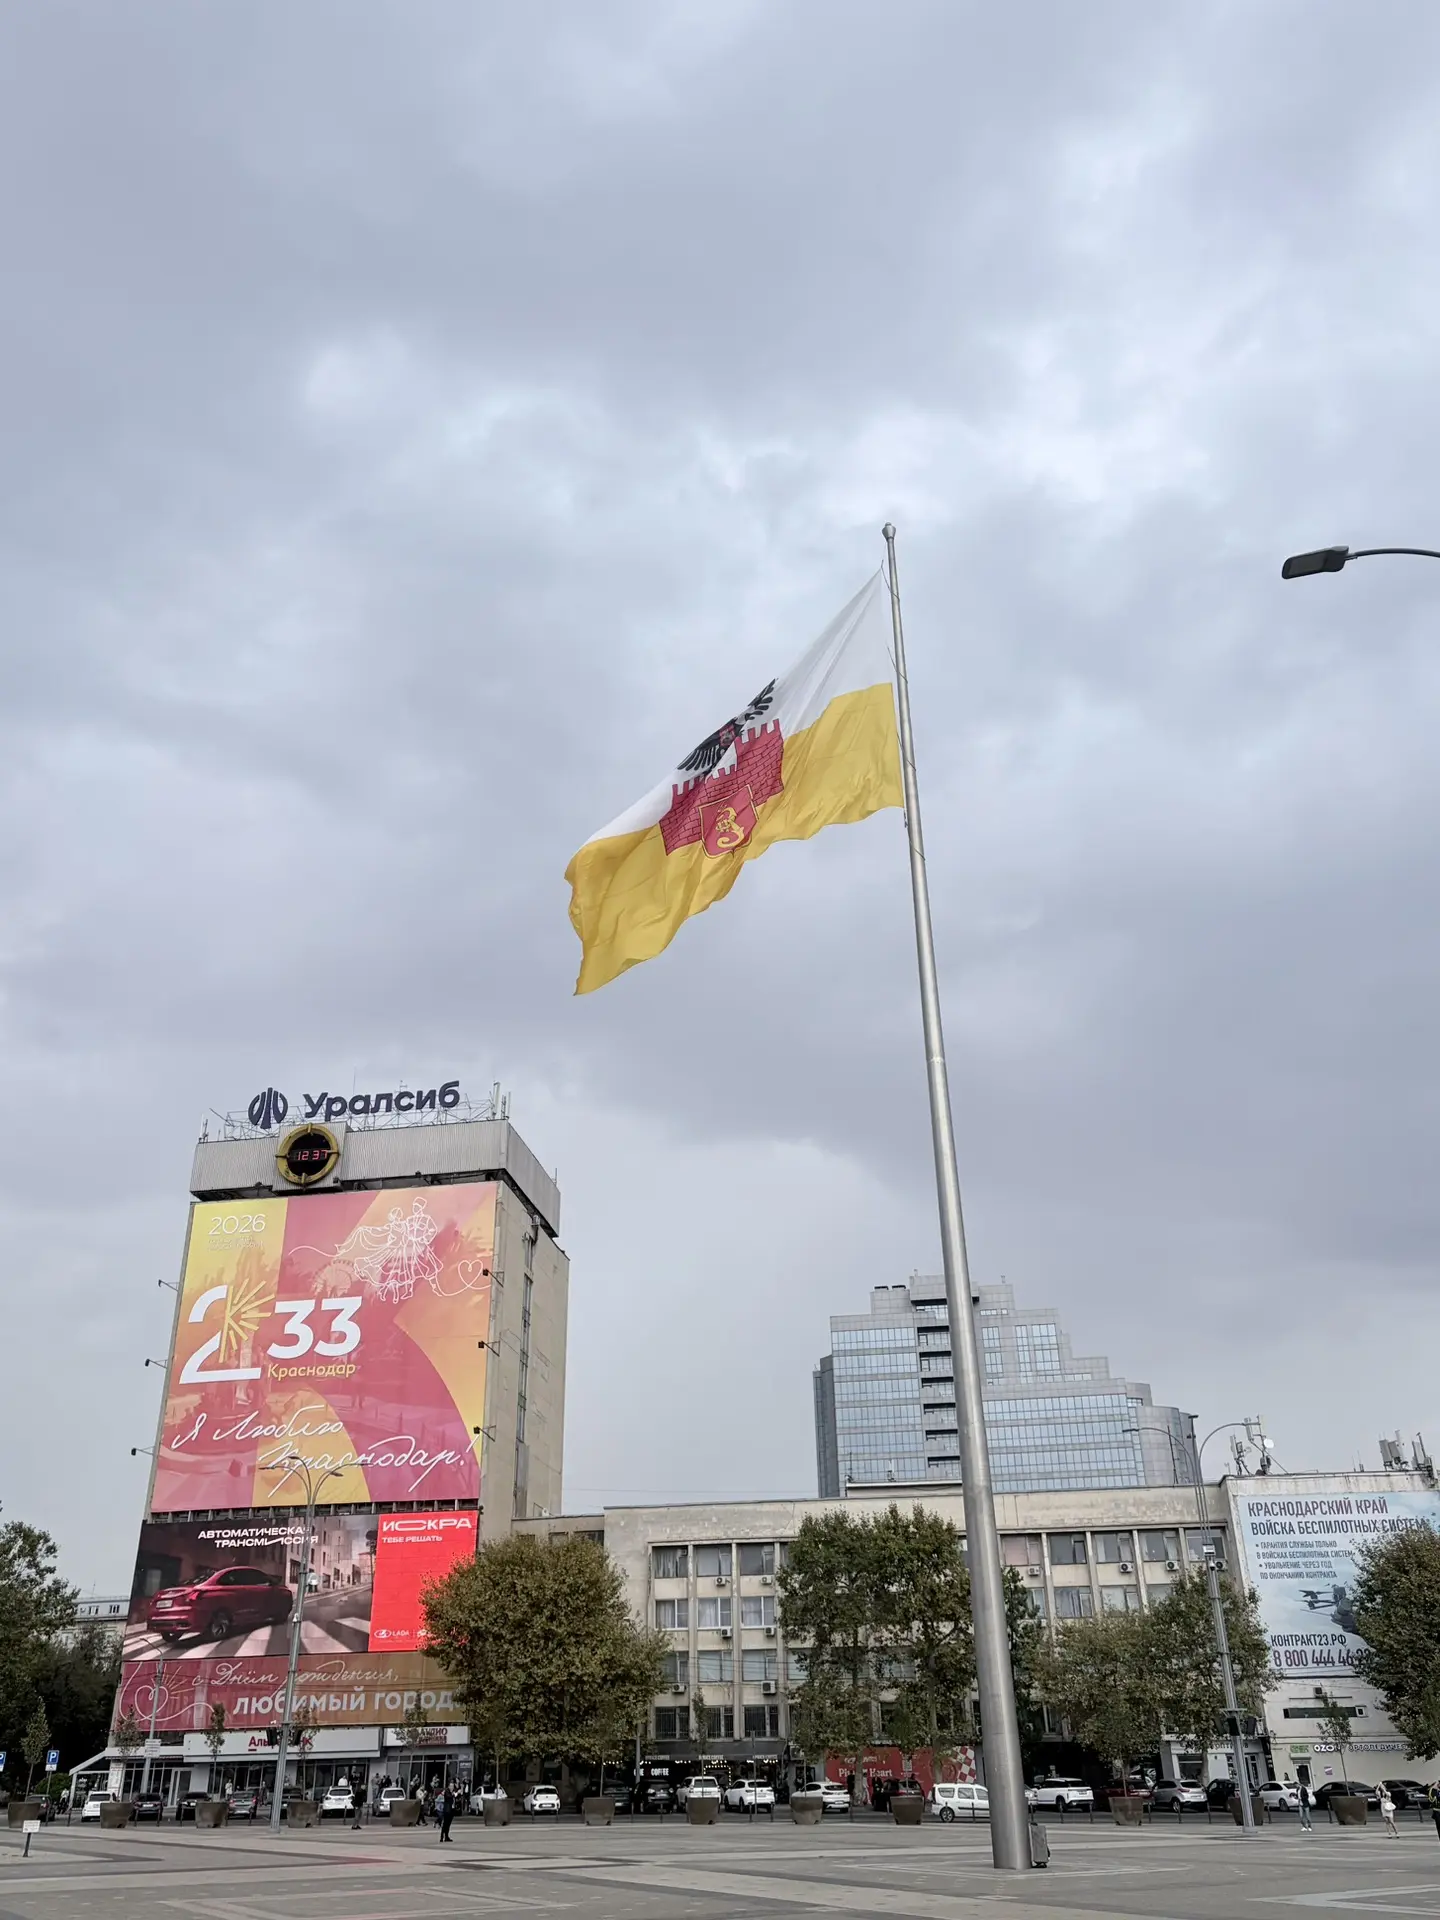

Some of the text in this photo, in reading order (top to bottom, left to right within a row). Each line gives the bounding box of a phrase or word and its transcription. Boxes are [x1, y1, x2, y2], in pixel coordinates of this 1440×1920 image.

[302, 1080, 460, 1122] Уралсиб
[208, 1213, 266, 1235] 2026
[267, 1362, 356, 1380] Краснодар
[170, 1412, 207, 1449] Я
[1247, 1496, 1388, 1518] КРАСНОДАРСКИЙ КРАЙ
[382, 1518, 472, 1532] ИСКРА
[1250, 1519, 1296, 1536] ВОЙСКА
[1299, 1519, 1379, 1535] БЕСПИЛОТНЫХ
[1260, 1541, 1288, 1549] ГАРАНТИЯ
[1314, 1540, 1337, 1548] ТОЛЬКО
[1262, 1550, 1288, 1559] ВОЙСКАХ
[1288, 1550, 1330, 1558] БЕСПИЛОТНЫХ
[1264, 1560, 1333, 1569] УВОЛЬНЕНИЕ ЧЕРЕЗ ГОД
[1260, 1571, 1338, 1580] ПО ОКОНЧАНИЮ КОНТРАКТА
[1271, 1633, 1346, 1647] КОНТРАКТ23.РФ
[1273, 1650, 1282, 1667] 8
[1284, 1649, 1308, 1667] 800
[1311, 1649, 1335, 1667] 444
[1338, 1649, 1354, 1667] 46
[650, 1767, 669, 1777] COFFEE
